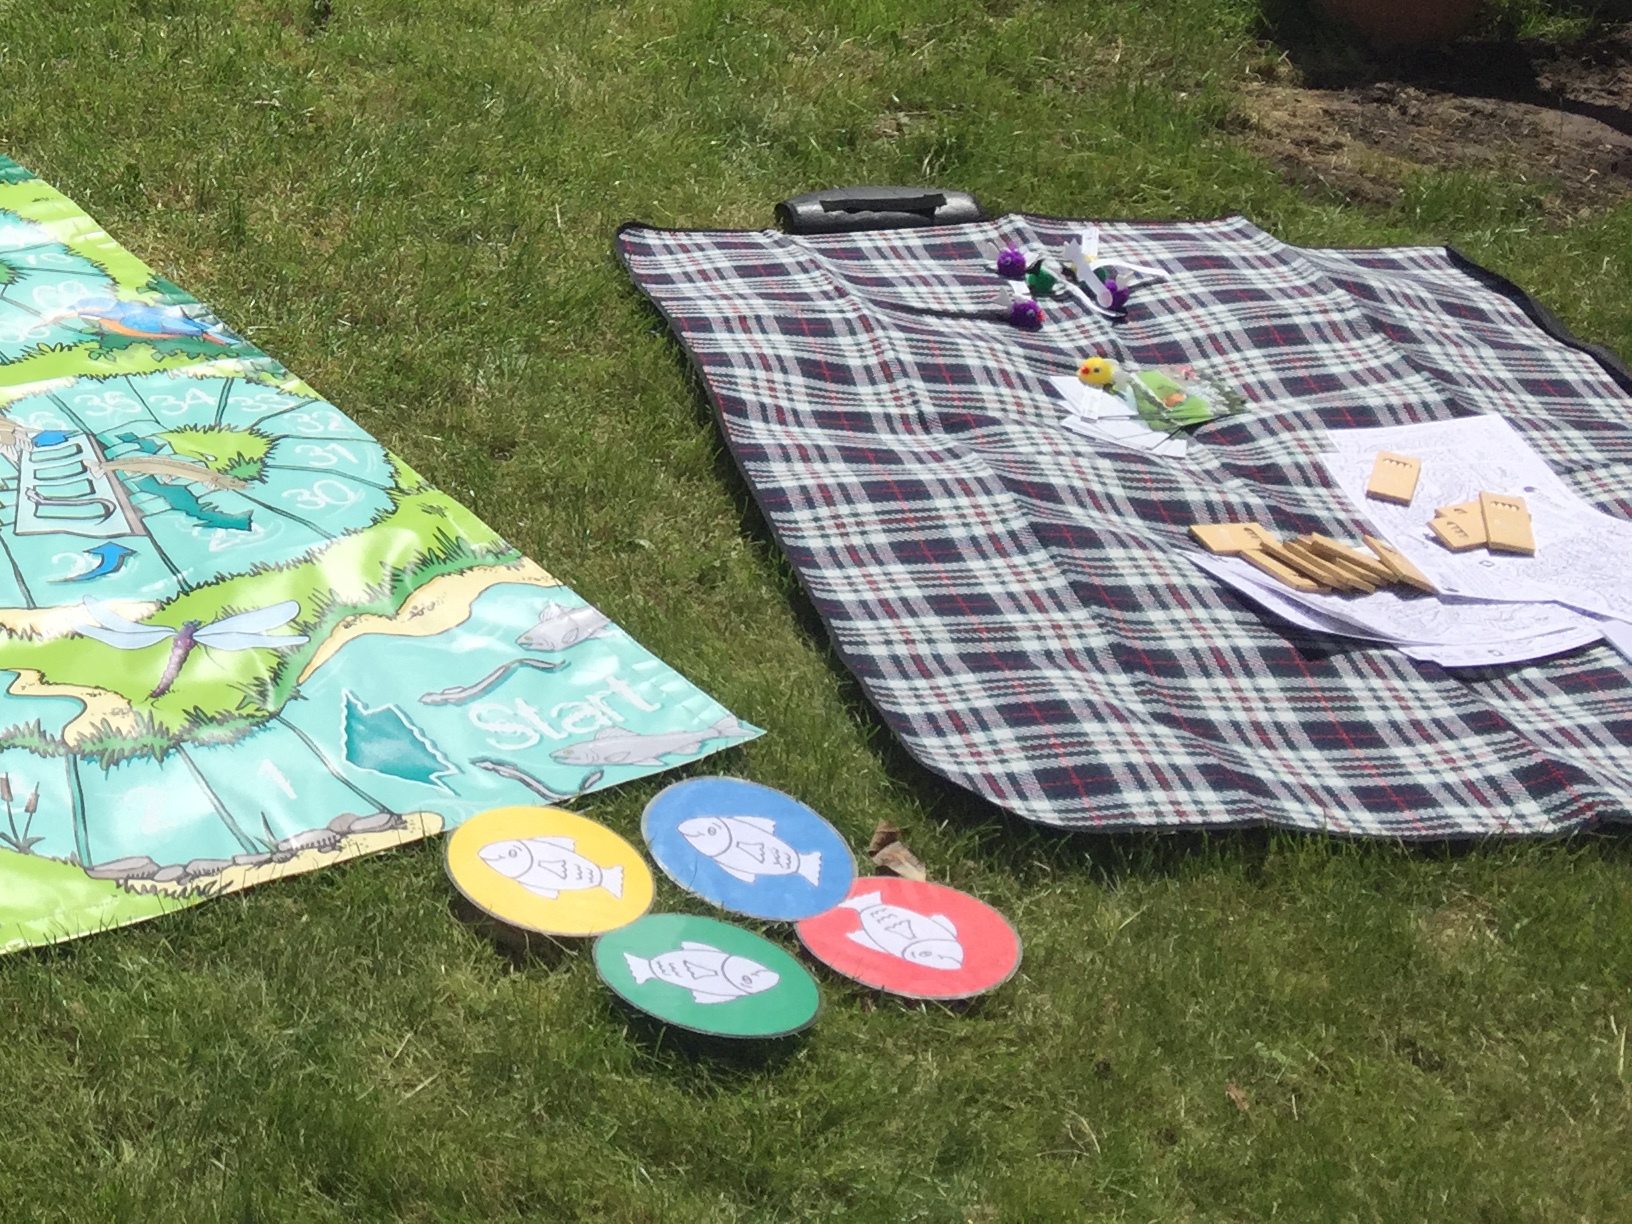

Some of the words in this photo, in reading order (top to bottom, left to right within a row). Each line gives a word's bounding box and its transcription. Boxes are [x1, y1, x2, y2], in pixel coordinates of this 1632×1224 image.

[74, 391, 142, 418] 35
[149, 388, 221, 416] 34
[230, 390, 294, 414] 33
[283, 410, 348, 434] 32
[304, 442, 359, 467] 31
[282, 479, 356, 510] 30
[469, 675, 662, 751] Start
